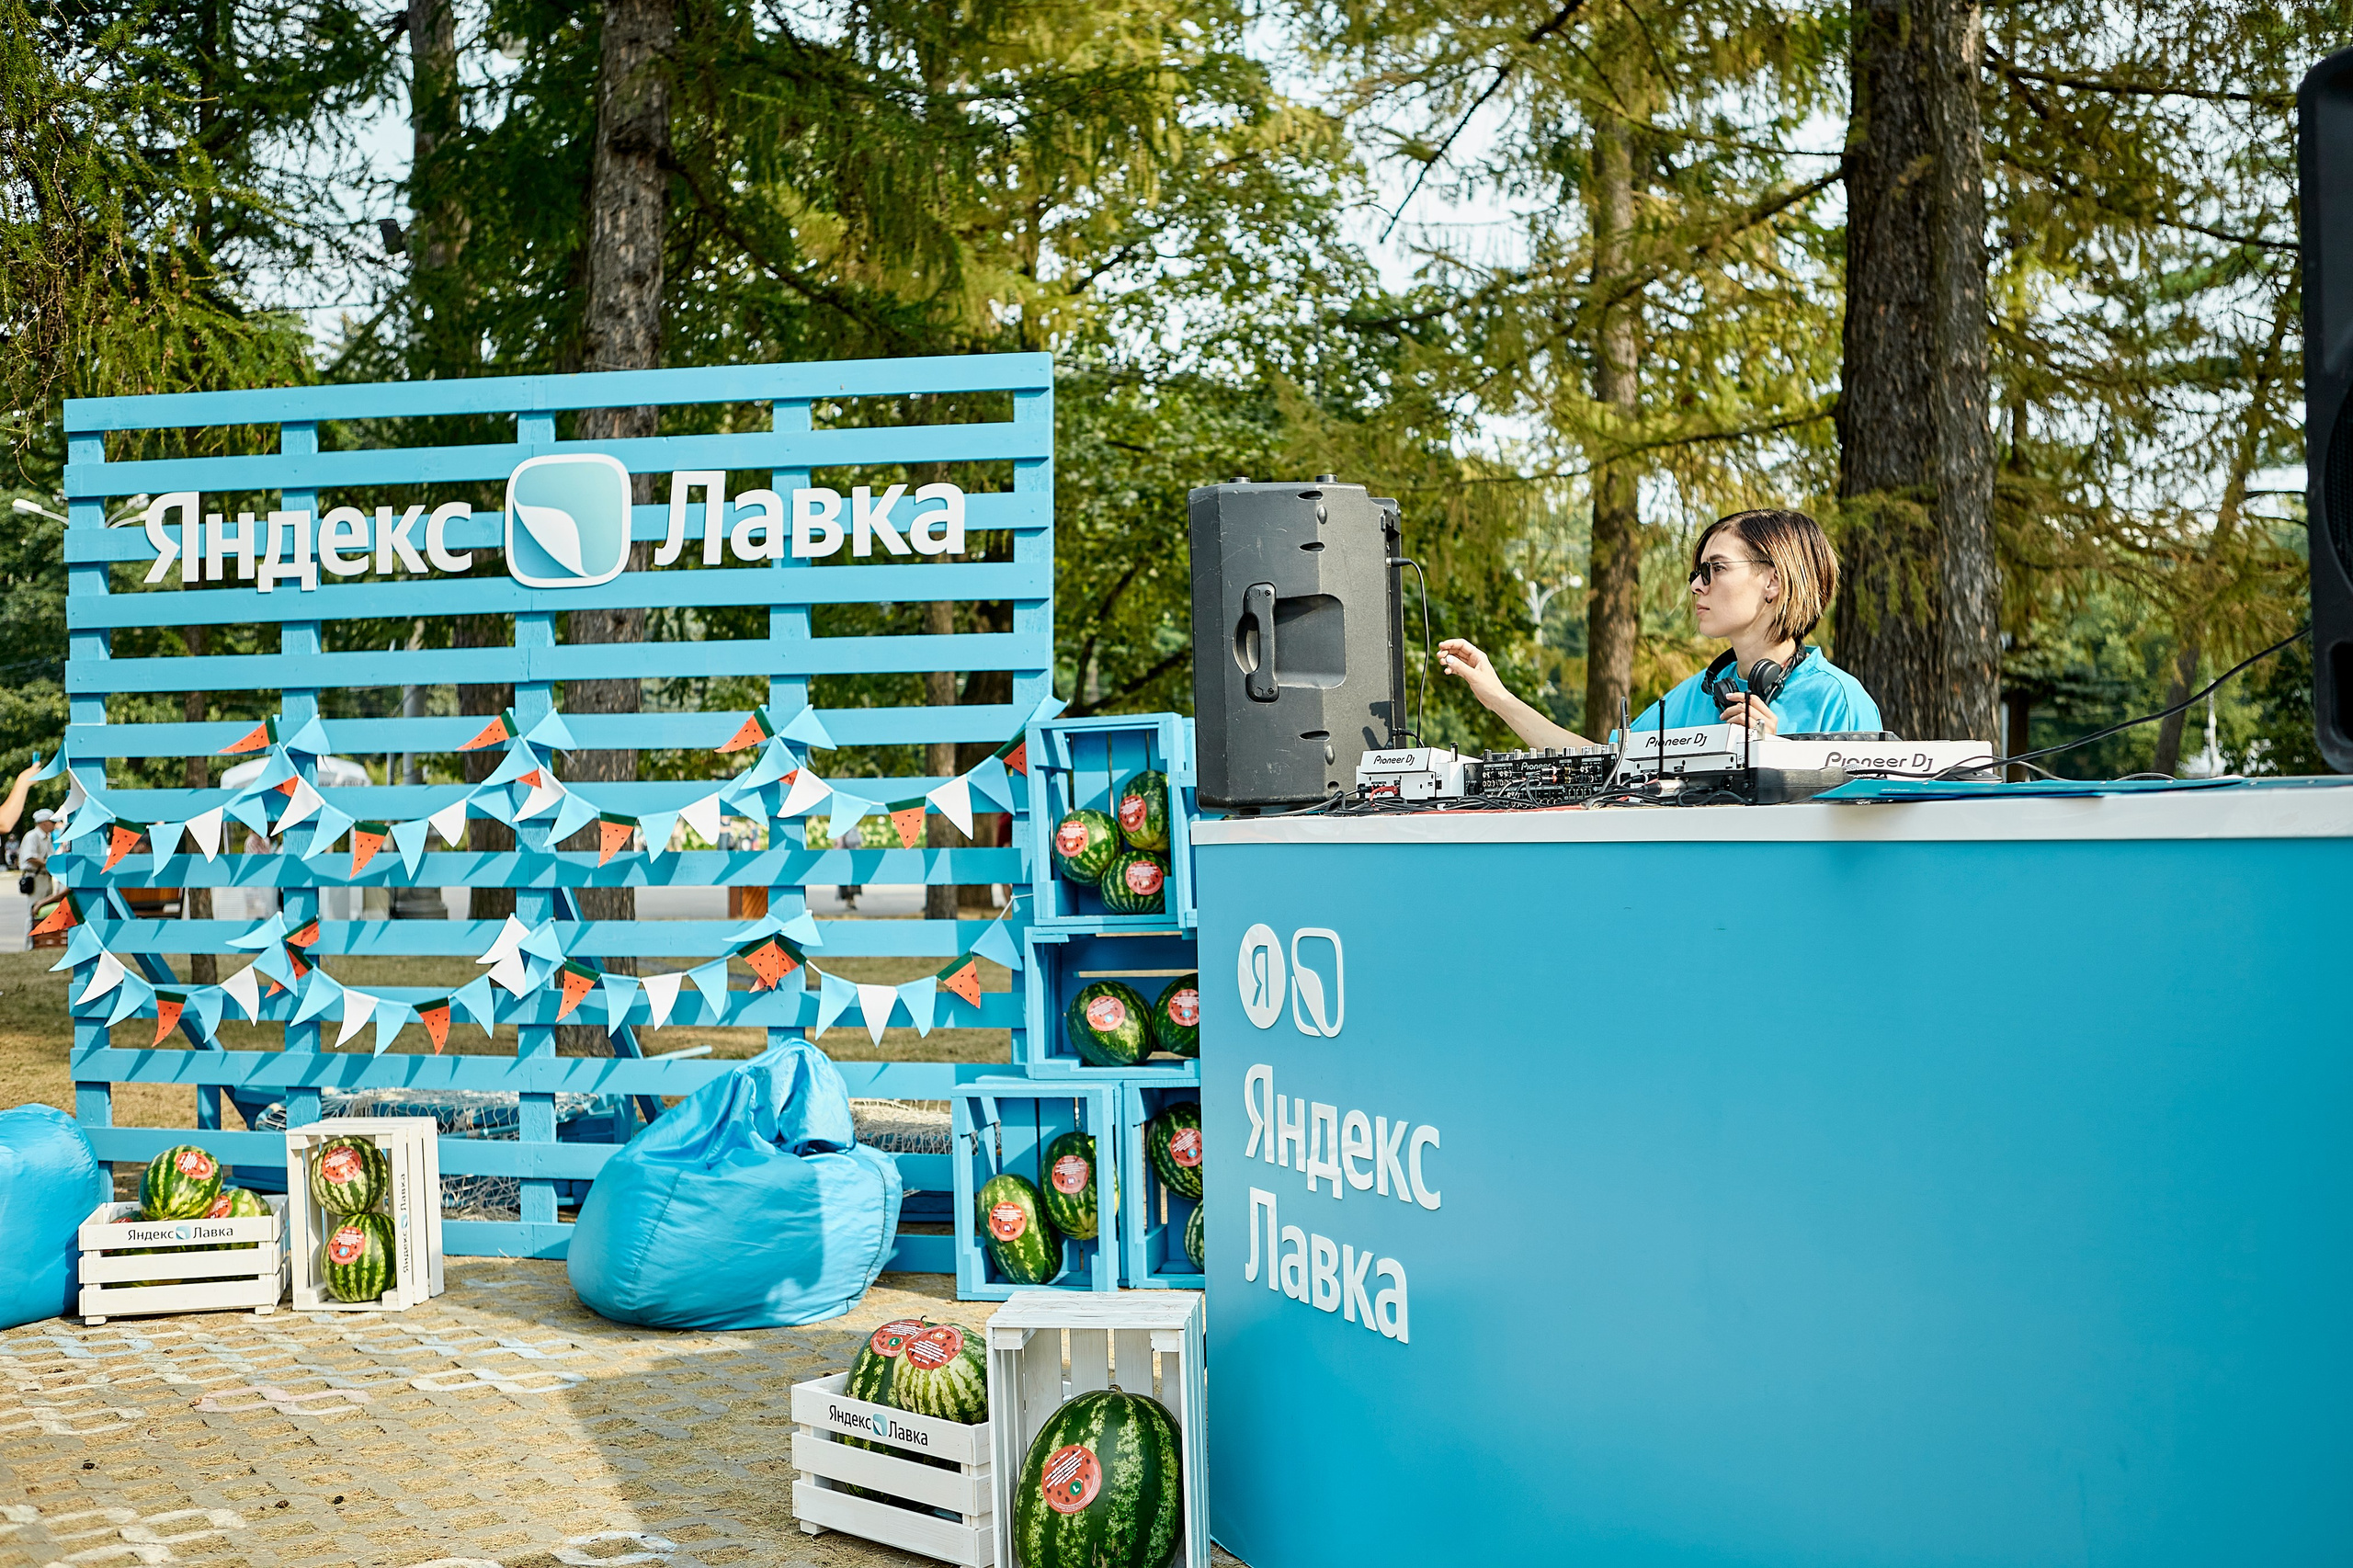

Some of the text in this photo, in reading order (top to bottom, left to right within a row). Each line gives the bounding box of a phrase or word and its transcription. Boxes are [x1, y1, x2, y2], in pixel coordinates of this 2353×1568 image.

[143, 471, 965, 592] Яндекс Лавка
[1373, 755, 1405, 765] Pioneer
[1251, 944, 1269, 1009] Я
[1245, 1063, 1441, 1210] Яндекс
[128, 1227, 233, 1241] Яндекс Лавка
[1245, 1187, 1409, 1344] Лавка
[829, 1405, 928, 1446] Яндекс Лавка
